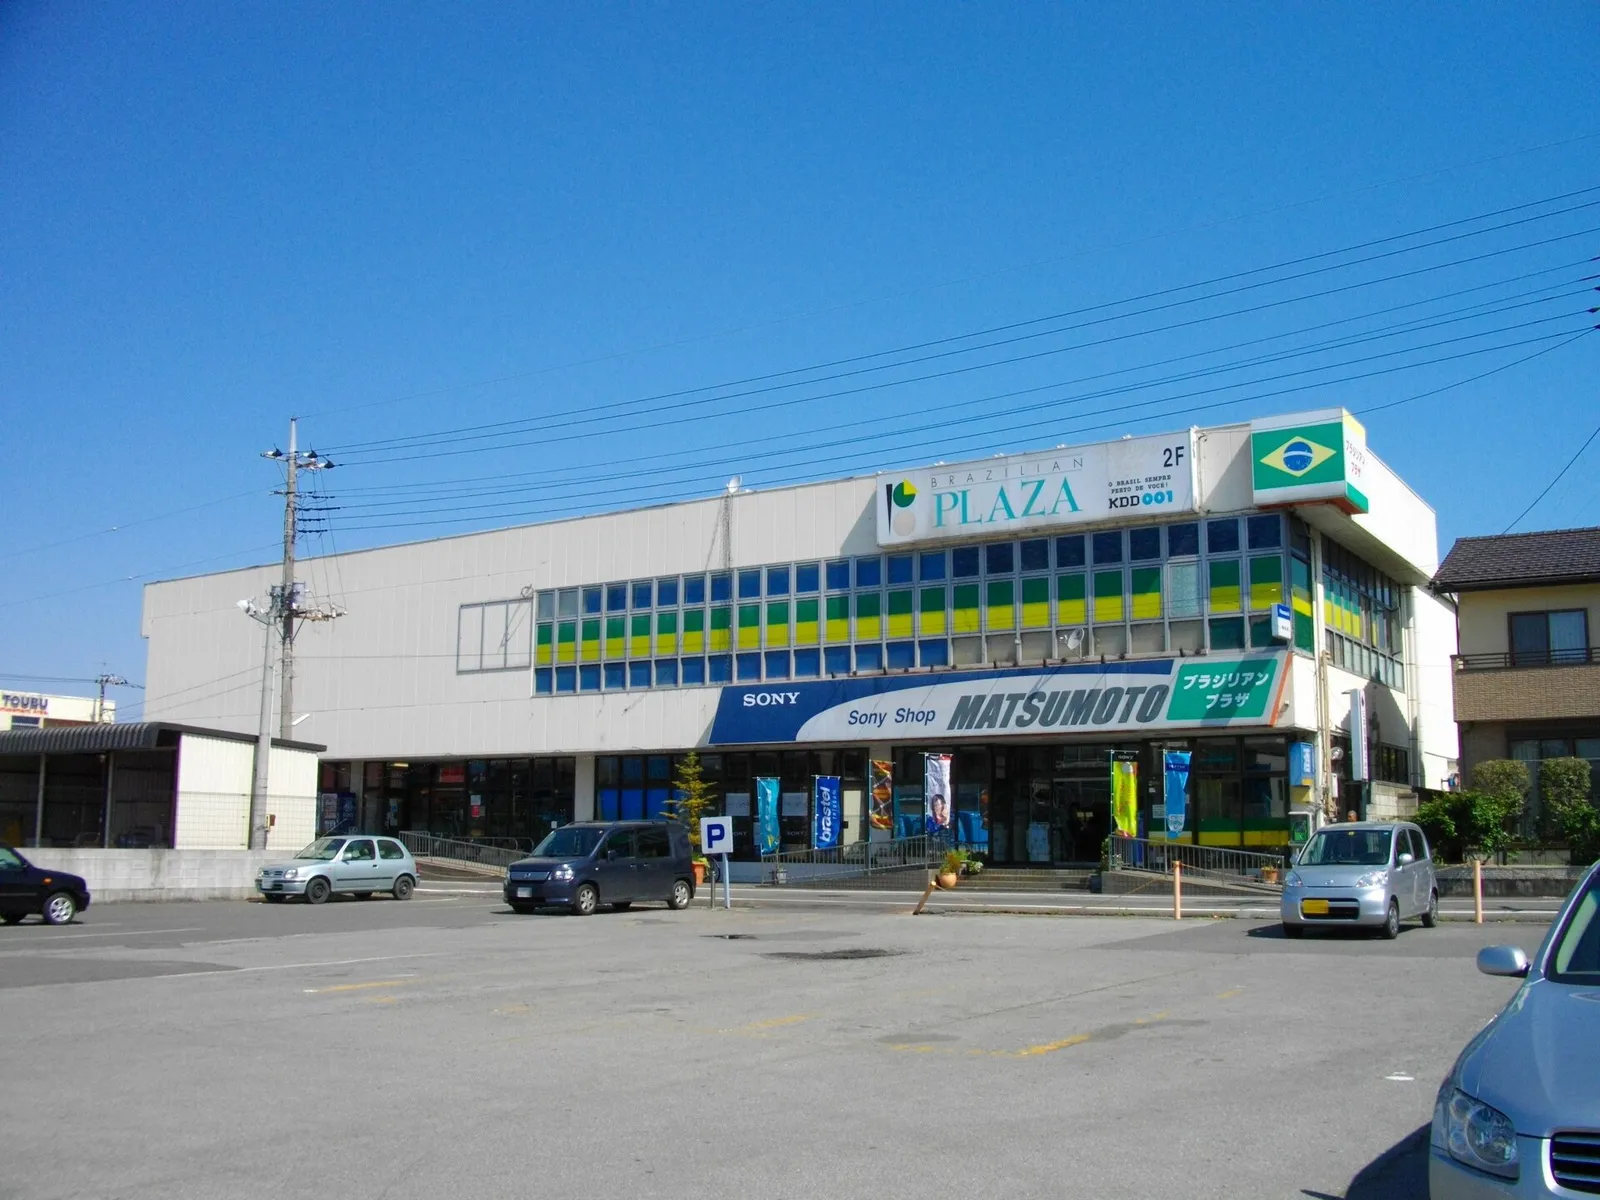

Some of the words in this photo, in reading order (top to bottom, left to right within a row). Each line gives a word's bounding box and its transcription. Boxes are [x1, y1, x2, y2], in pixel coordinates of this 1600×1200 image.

[1163, 446, 1184, 468] 2F
[931, 457, 1083, 488] BRAZILIAN
[1116, 478, 1141, 486] BRASIL
[933, 476, 1083, 528] PLAZA
[1183, 671, 1270, 691] ブラジリアン
[3, 695, 48, 709] TOUBU
[743, 691, 800, 707] SONY
[947, 684, 1170, 731] MATSUMOTO
[848, 709, 887, 728] Sony
[895, 707, 936, 726] Shop
[819, 786, 831, 842] brastel
[707, 823, 725, 849] P
